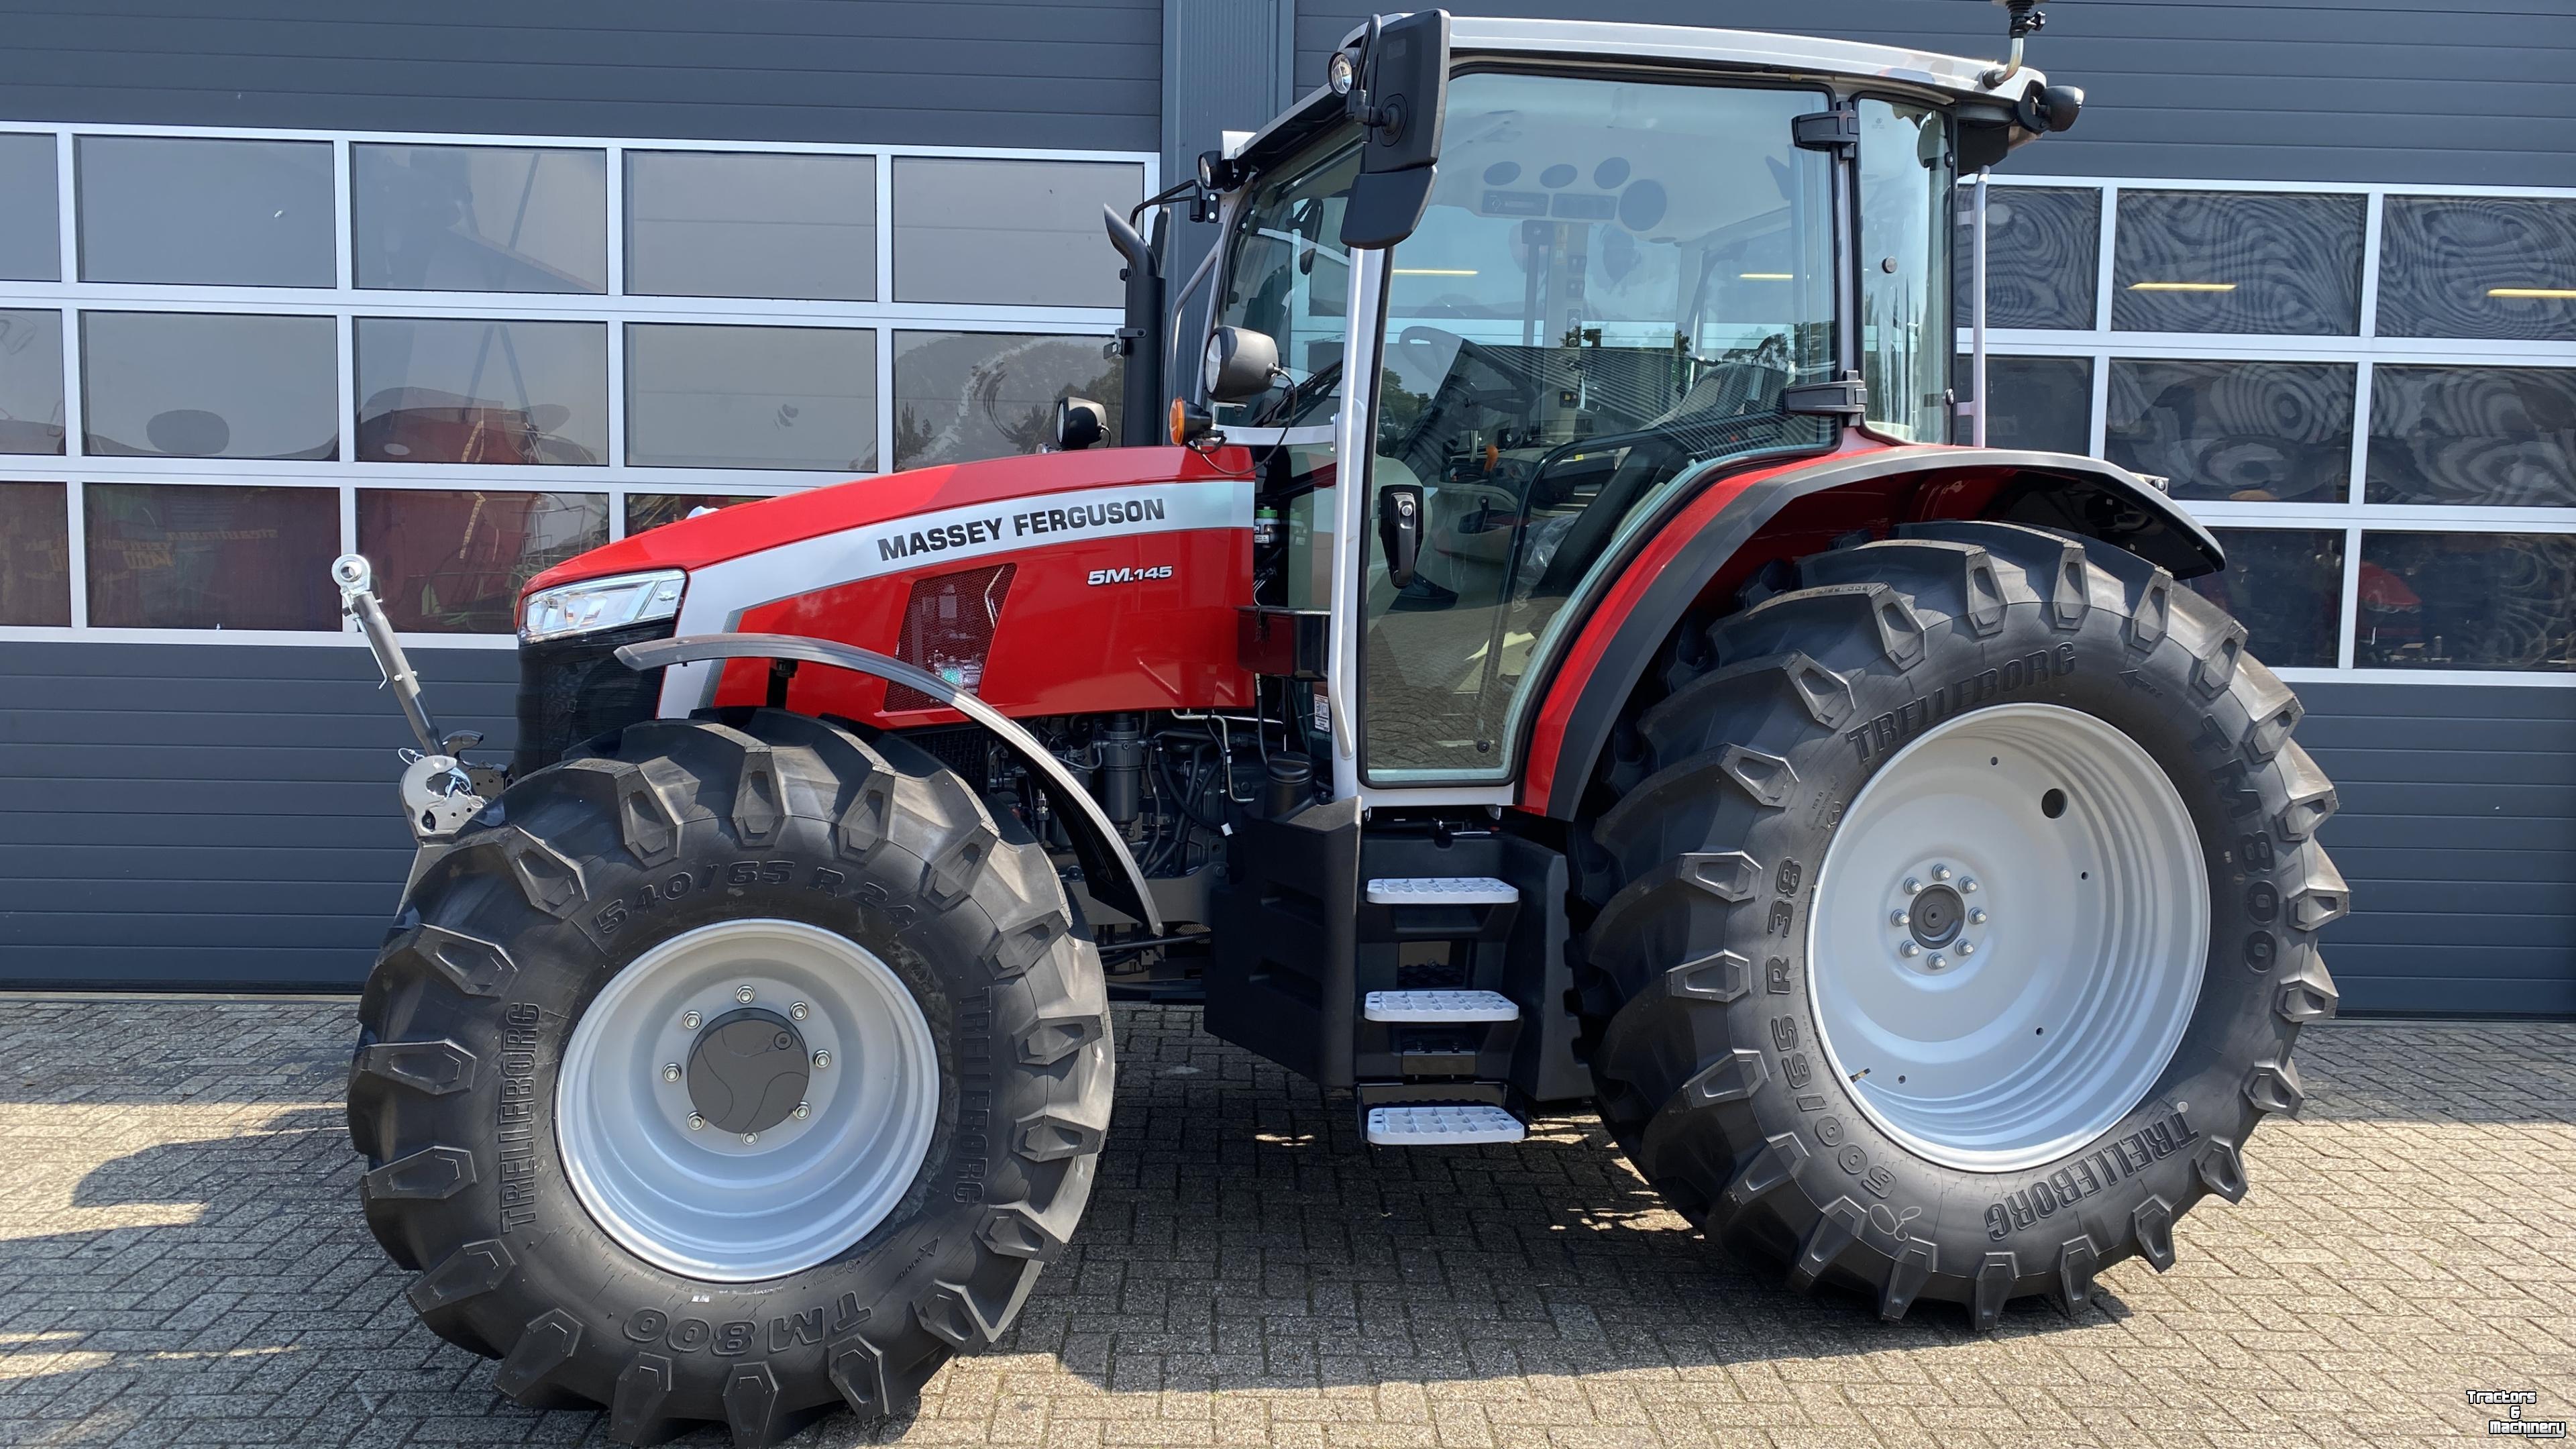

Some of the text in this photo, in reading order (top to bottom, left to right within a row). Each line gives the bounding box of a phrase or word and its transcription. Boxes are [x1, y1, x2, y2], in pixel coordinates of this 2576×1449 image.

[877, 498, 1165, 561] MASSEY FERGUSON
[1846, 641, 2076, 763] TRELLEBORG
[594, 861, 916, 934] 540/65 R 24
[1768, 856, 1802, 937] 38
[1766, 955, 1790, 994] R
[500, 1002, 541, 1234] TRELLEBORG
[953, 986, 991, 1203] TRELLEBORG
[1771, 1014, 1897, 1199] 500/65
[1984, 1112, 2199, 1241] TRELLEBORG
